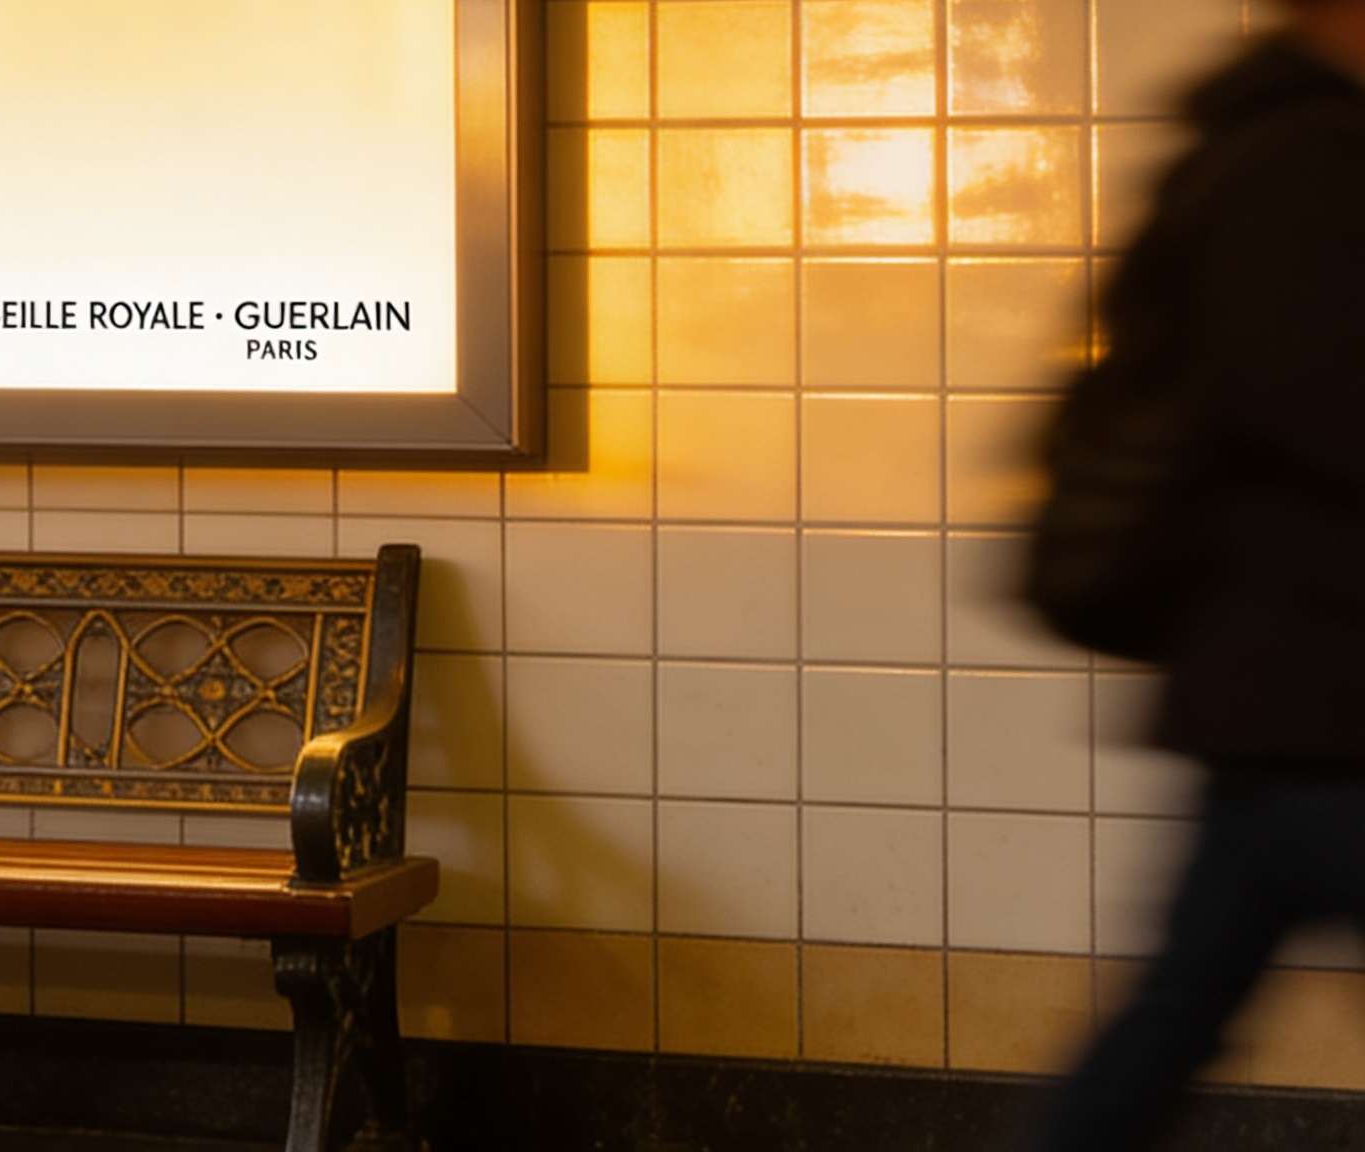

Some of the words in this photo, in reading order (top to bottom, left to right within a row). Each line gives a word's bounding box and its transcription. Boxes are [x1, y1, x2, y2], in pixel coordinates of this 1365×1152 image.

[89, 300, 205, 330] ROYALE
[234, 300, 411, 331] GUERLAIN
[246, 338, 318, 361] PARIS
